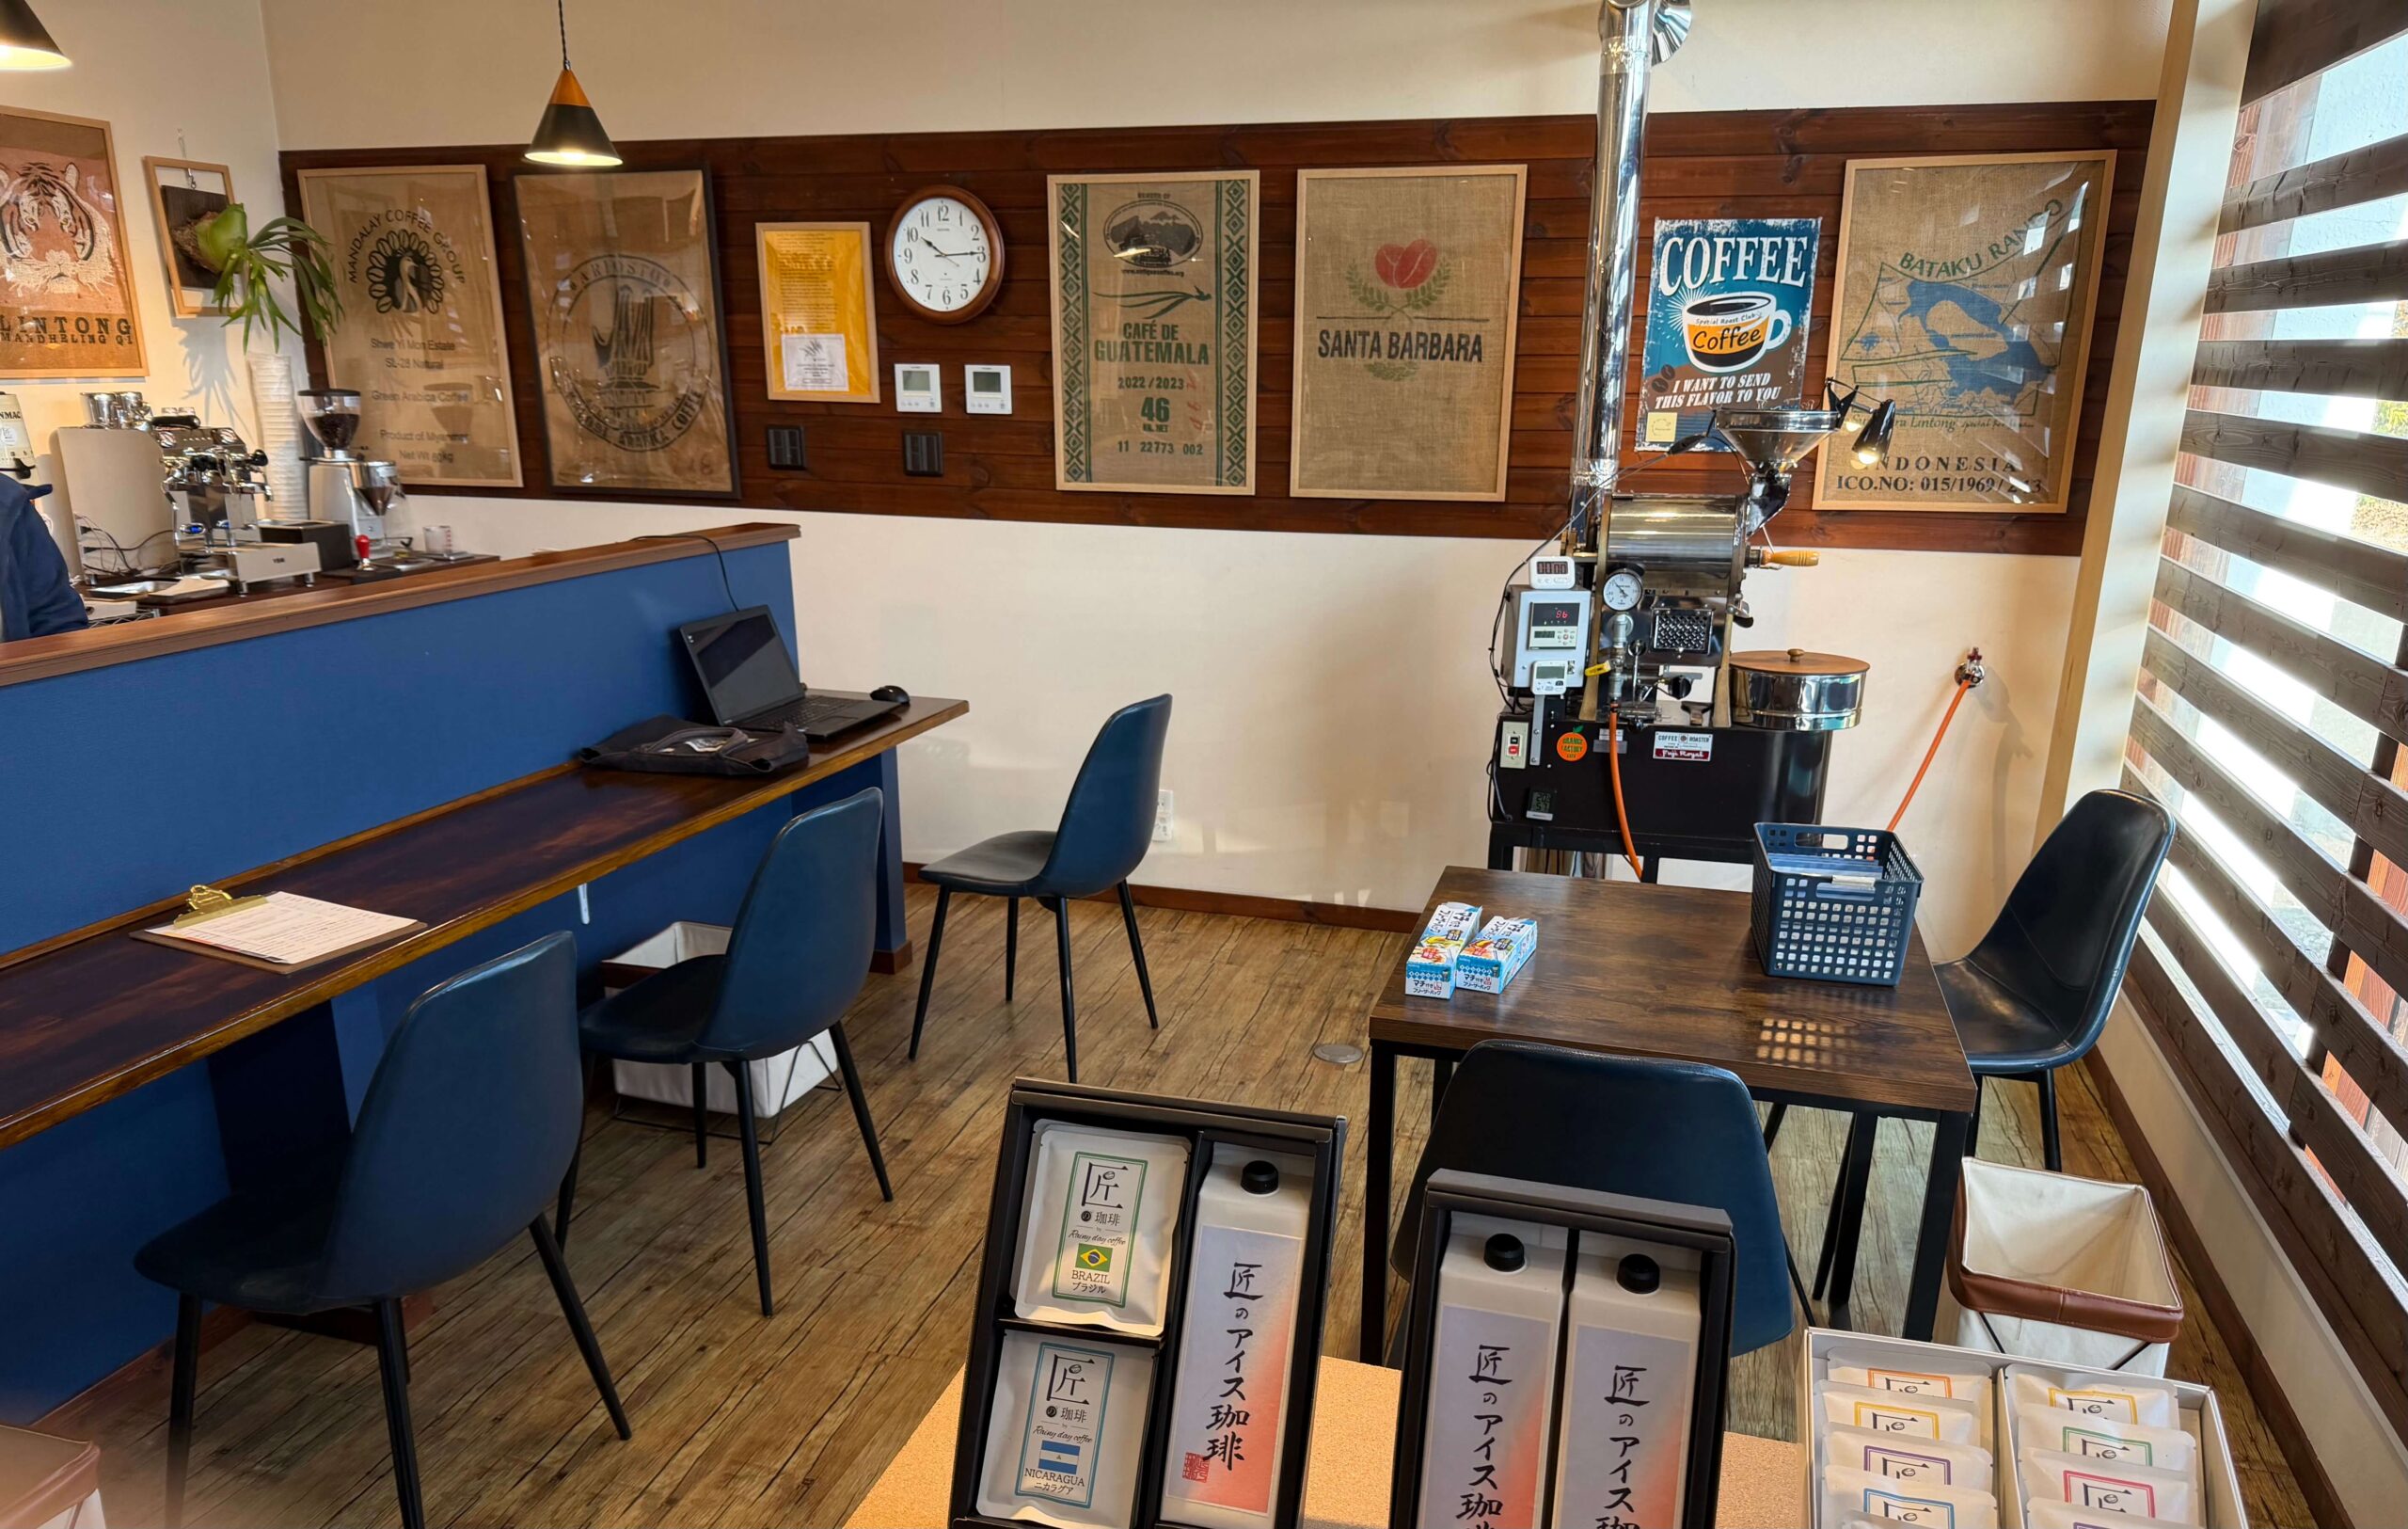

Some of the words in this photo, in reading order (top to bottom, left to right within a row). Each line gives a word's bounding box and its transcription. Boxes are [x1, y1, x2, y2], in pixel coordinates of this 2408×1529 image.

[921, 211, 929, 227] 11
[937, 205, 949, 221] 12
[958, 210, 963, 226] 1
[906, 227, 919, 243] 10
[971, 225, 980, 241] 2
[348, 214, 382, 283] MANDALAY
[385, 209, 432, 233] COFFEE
[904, 247, 912, 263] 9
[976, 246, 987, 263] 3
[1658, 236, 1808, 296] COFFEE
[1899, 252, 1982, 279] BATAKU
[911, 269, 919, 285] 8
[973, 268, 982, 285] 4
[925, 284, 933, 300] 7
[942, 288, 951, 305] 6
[959, 284, 969, 299] 5
[1741, 311, 1755, 321] Club
[0, 314, 131, 335] LINTONG
[1123, 320, 1157, 339] CAFÉ
[1162, 325, 1179, 341] DE
[0, 332, 106, 343] MANDHELING
[1318, 329, 1382, 358] SANTA
[1387, 331, 1482, 362] BARBARA
[1693, 326, 1762, 350] Coffee
[1094, 340, 1210, 365] GUATEMALA
[1117, 376, 1184, 390] 2022/2023
[1671, 380, 1681, 393] I
[1683, 377, 1718, 392] WANT
[1719, 375, 1736, 390] TO
[1737, 373, 1771, 388] SEND
[1655, 395, 1686, 409] THIS
[1687, 390, 1735, 406] FLAVOR
[1736, 389, 1754, 403] TO
[1756, 387, 1782, 401] YOU
[1141, 397, 1170, 422] 46
[1910, 416, 1956, 432] Lintong
[1117, 440, 1129, 453] 11
[1140, 441, 1174, 454] 22773
[1182, 443, 1203, 455] 002
[1876, 456, 2017, 470] NDONESIA
[1837, 476, 1914, 490] ICO.NO:
[1069, 1229, 1091, 1242] Rainy
[1091, 1232, 1107, 1245] day
[1107, 1235, 1126, 1247] coffee
[1071, 1269, 1111, 1284] BRAZIL
[1072, 1282, 1106, 1294] ブラジル
[1202, 1262, 1264, 1472] 匠のアイス珈琲
[1033, 1425, 1056, 1439] Rainy
[1056, 1428, 1072, 1441] day
[1073, 1434, 1093, 1444] coffee
[1455, 1344, 1513, 1529] 匠のアイス珈
[1024, 1467, 1085, 1487] NICARAGUA
[1034, 1482, 1074, 1495] ニカラグア
